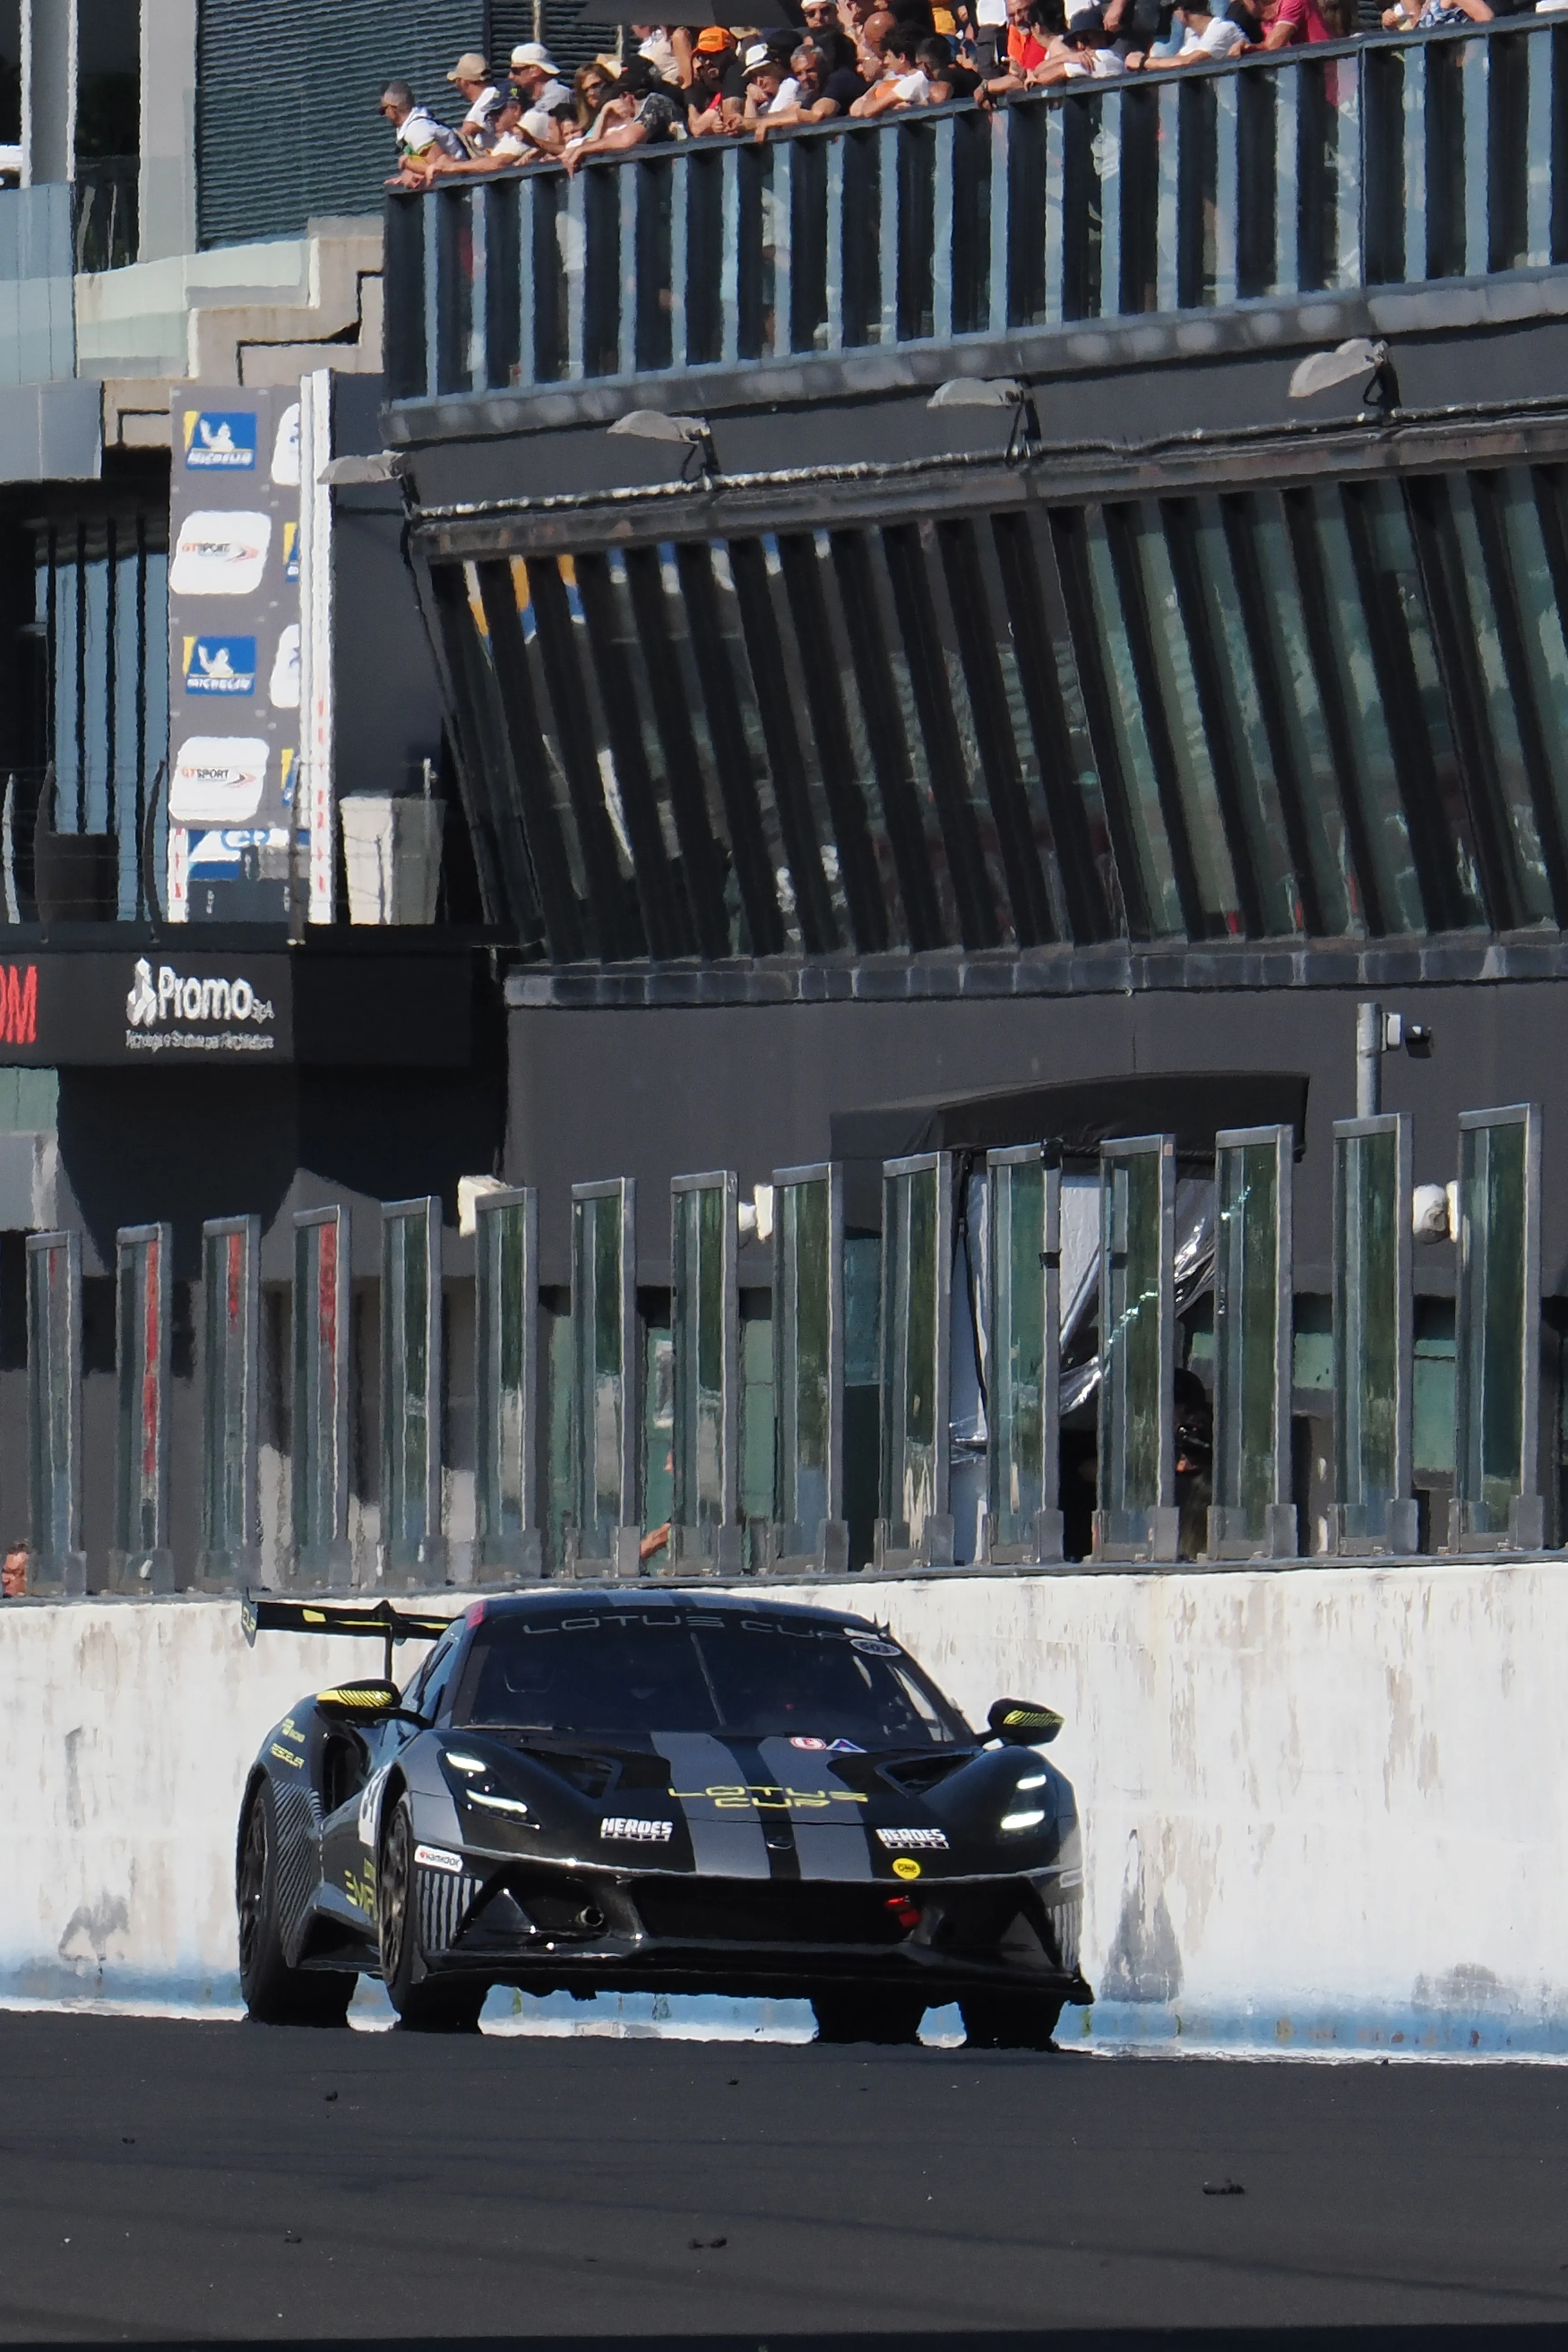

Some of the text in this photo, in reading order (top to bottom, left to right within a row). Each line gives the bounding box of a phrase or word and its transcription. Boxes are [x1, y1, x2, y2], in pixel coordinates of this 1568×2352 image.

[187, 678, 251, 692] MICHELIN
[158, 965, 253, 1020] Promo
[523, 1615, 725, 1634] LOTUS
[668, 1785, 868, 1803] LOTUS
[715, 1797, 831, 1808] CUP
[601, 1818, 673, 1834] HEROES
[875, 1828, 946, 1842] HEROES
